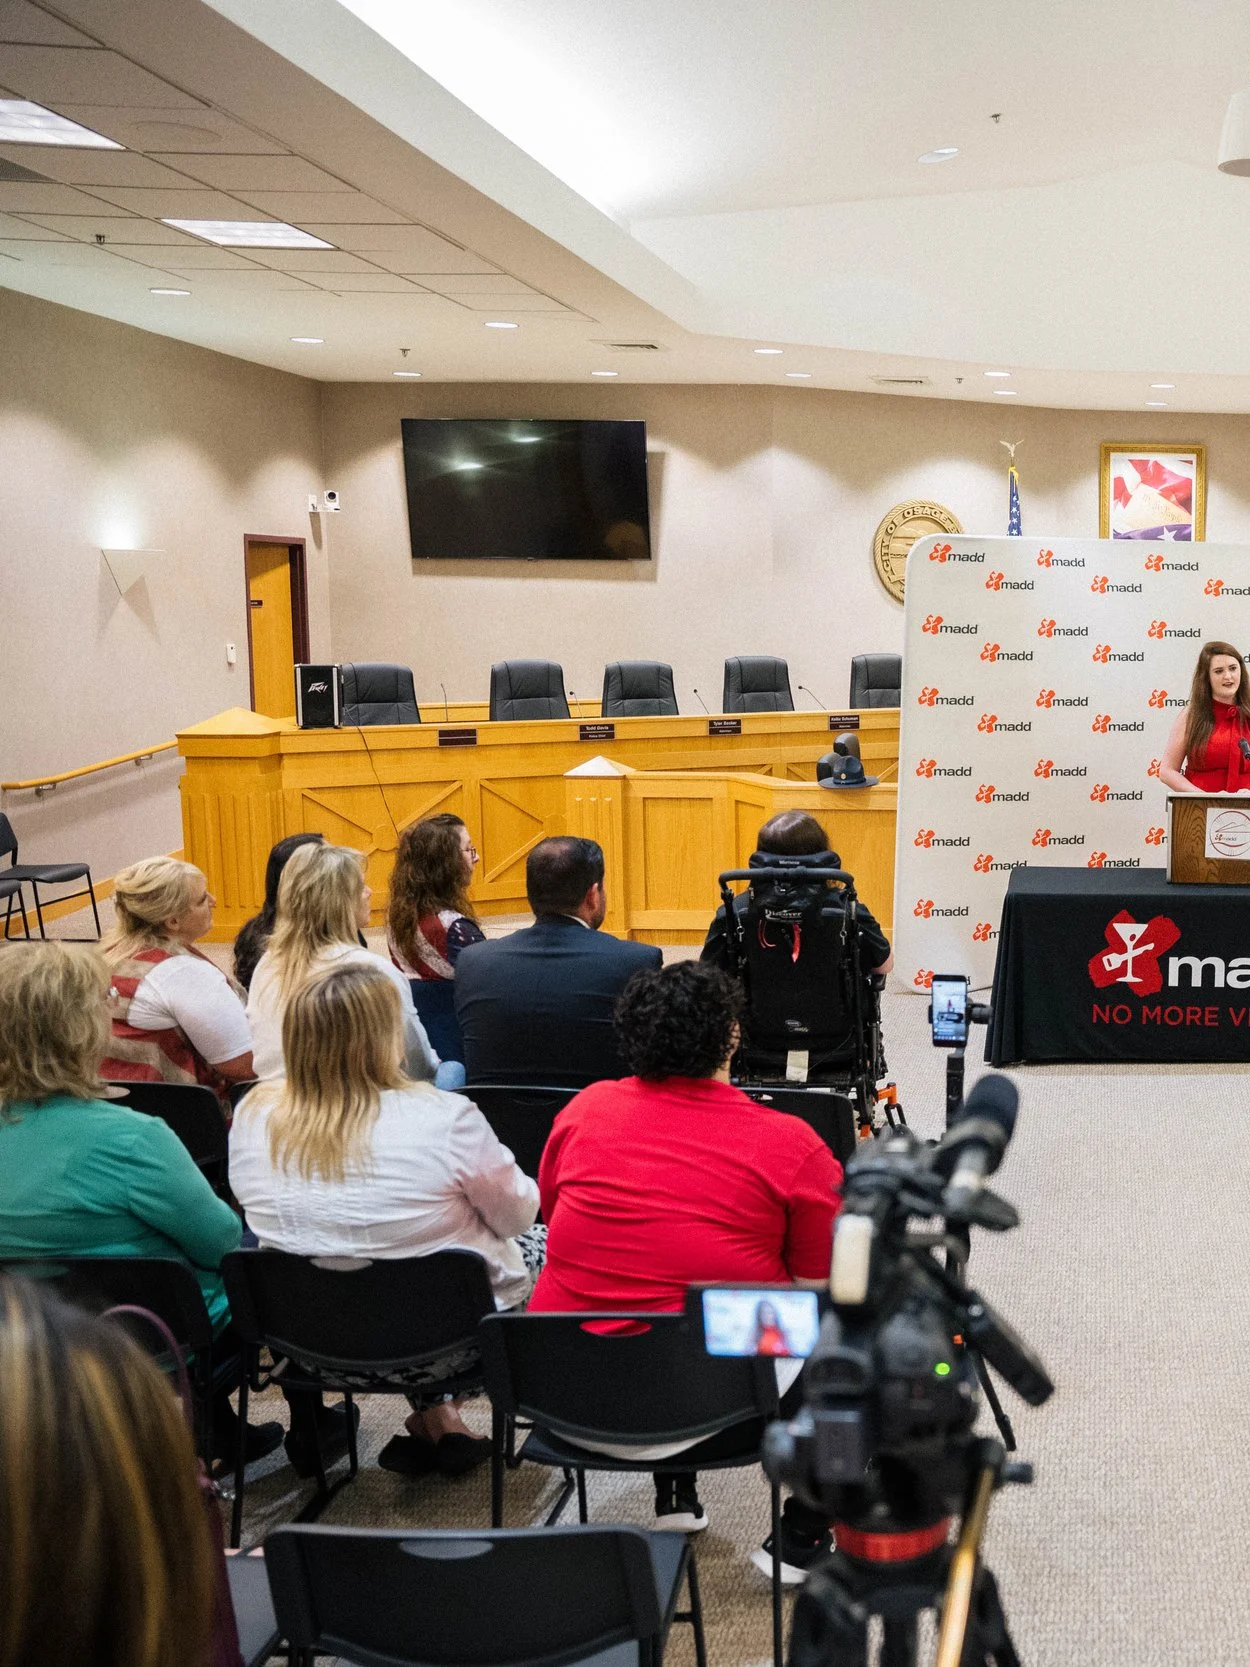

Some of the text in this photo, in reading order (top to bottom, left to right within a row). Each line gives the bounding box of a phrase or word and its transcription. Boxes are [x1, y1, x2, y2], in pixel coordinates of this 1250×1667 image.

[903, 506, 949, 524] OSAGE
[947, 552, 985, 563] madd
[1051, 557, 1085, 568] madd
[1161, 561, 1198, 572] madd
[1000, 580, 1034, 591] madd
[1106, 583, 1141, 593] madd
[939, 623, 978, 635] madd
[1053, 626, 1088, 637] madd
[1164, 627, 1200, 638] madd
[996, 650, 1033, 661] madd
[1108, 651, 1144, 662] madd
[935, 695, 974, 706] madd
[1052, 696, 1088, 707] madd
[1165, 698, 1190, 707] ma
[994, 721, 1031, 732] madd
[1108, 721, 1144, 732] madd
[933, 766, 971, 777] madd
[1050, 766, 1087, 777] madd
[992, 791, 1029, 802] madd
[1106, 790, 1143, 801] madd
[931, 836, 970, 847] madd
[1048, 834, 1084, 846] madd
[1103, 857, 1140, 868] madd
[931, 905, 968, 917] madd
[1091, 1003, 1133, 1025] NO
[1141, 1004, 1220, 1028] MORE
